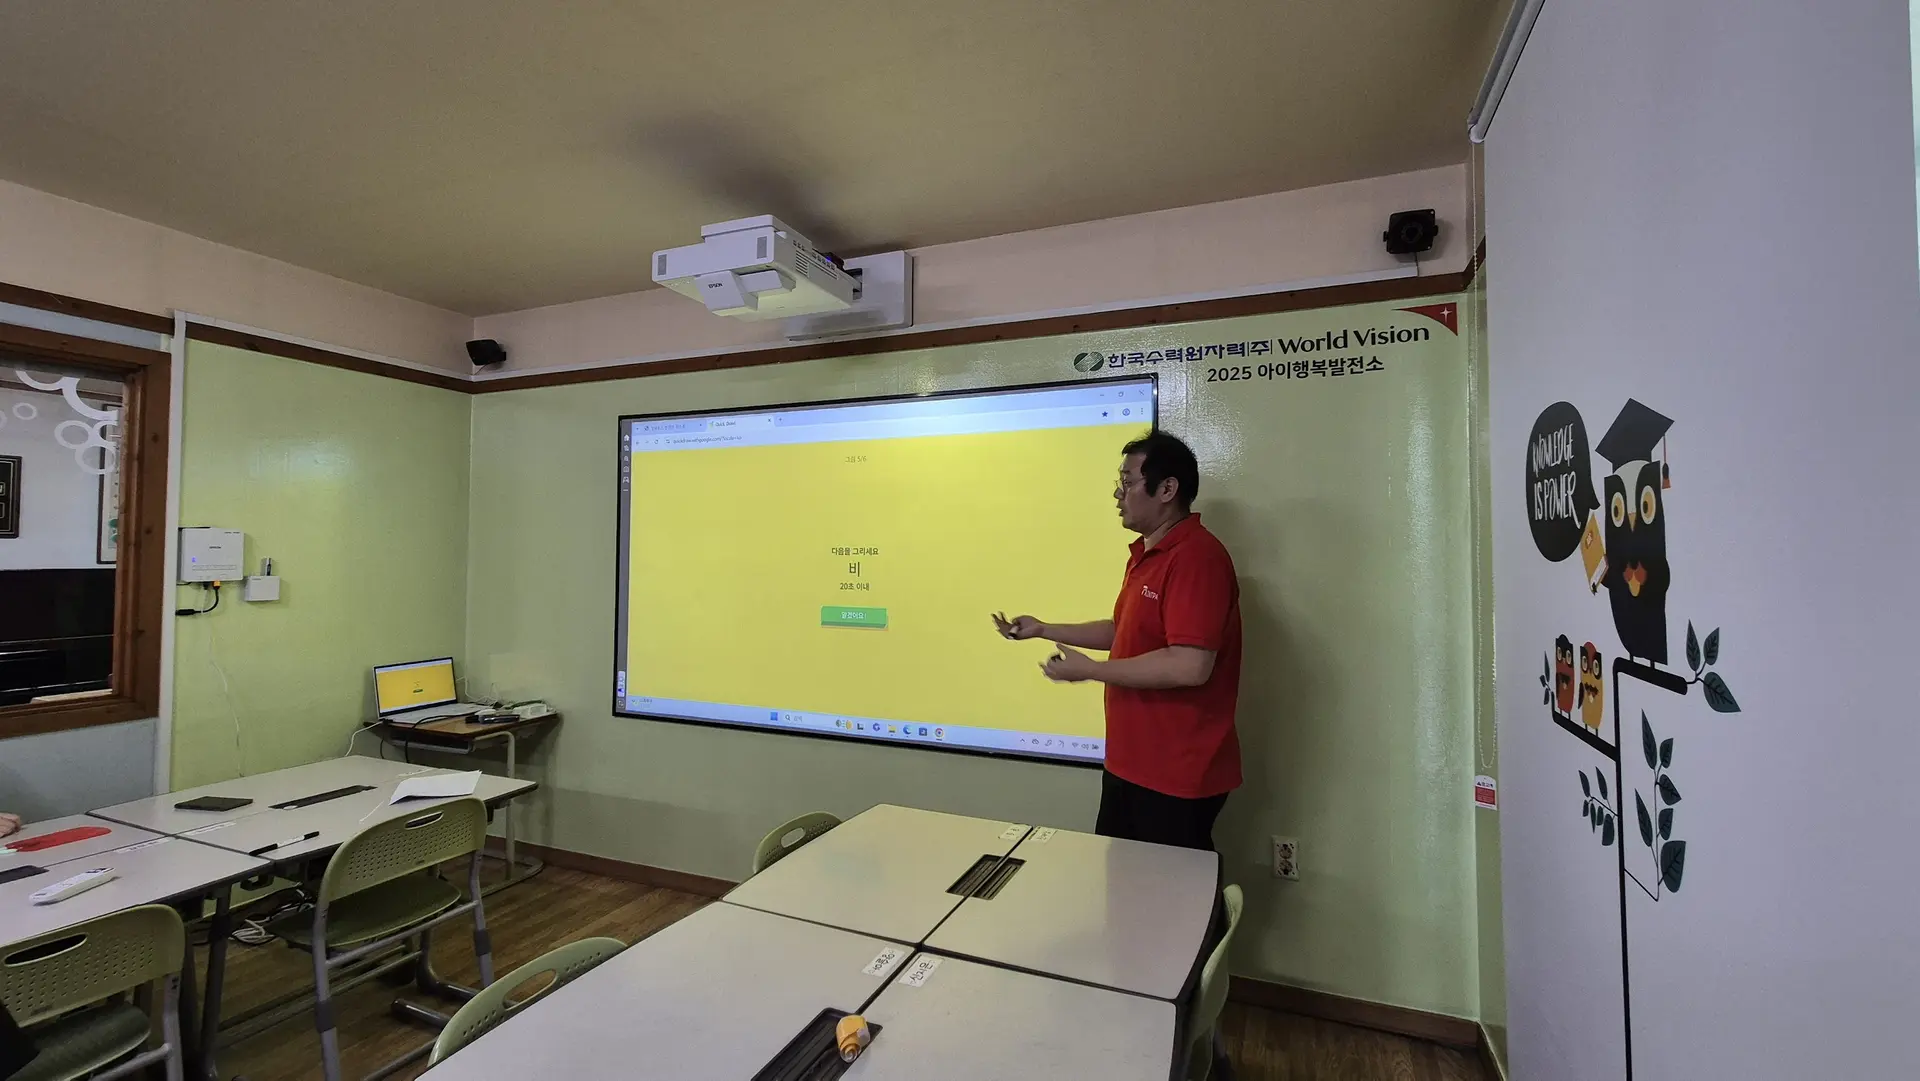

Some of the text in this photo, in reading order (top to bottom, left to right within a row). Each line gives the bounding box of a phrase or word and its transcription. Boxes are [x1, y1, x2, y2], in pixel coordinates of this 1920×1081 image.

[1277, 329, 1348, 354] World
[1353, 325, 1430, 347] Vision
[1207, 355, 1385, 383] 2025 아이행복발전소
[1532, 423, 1575, 477] KNOWLEDGE
[1534, 471, 1581, 529] IS POWER
[831, 547, 879, 556] 다음을 그리세요
[849, 562, 860, 577] 비
[840, 582, 854, 591] 20초
